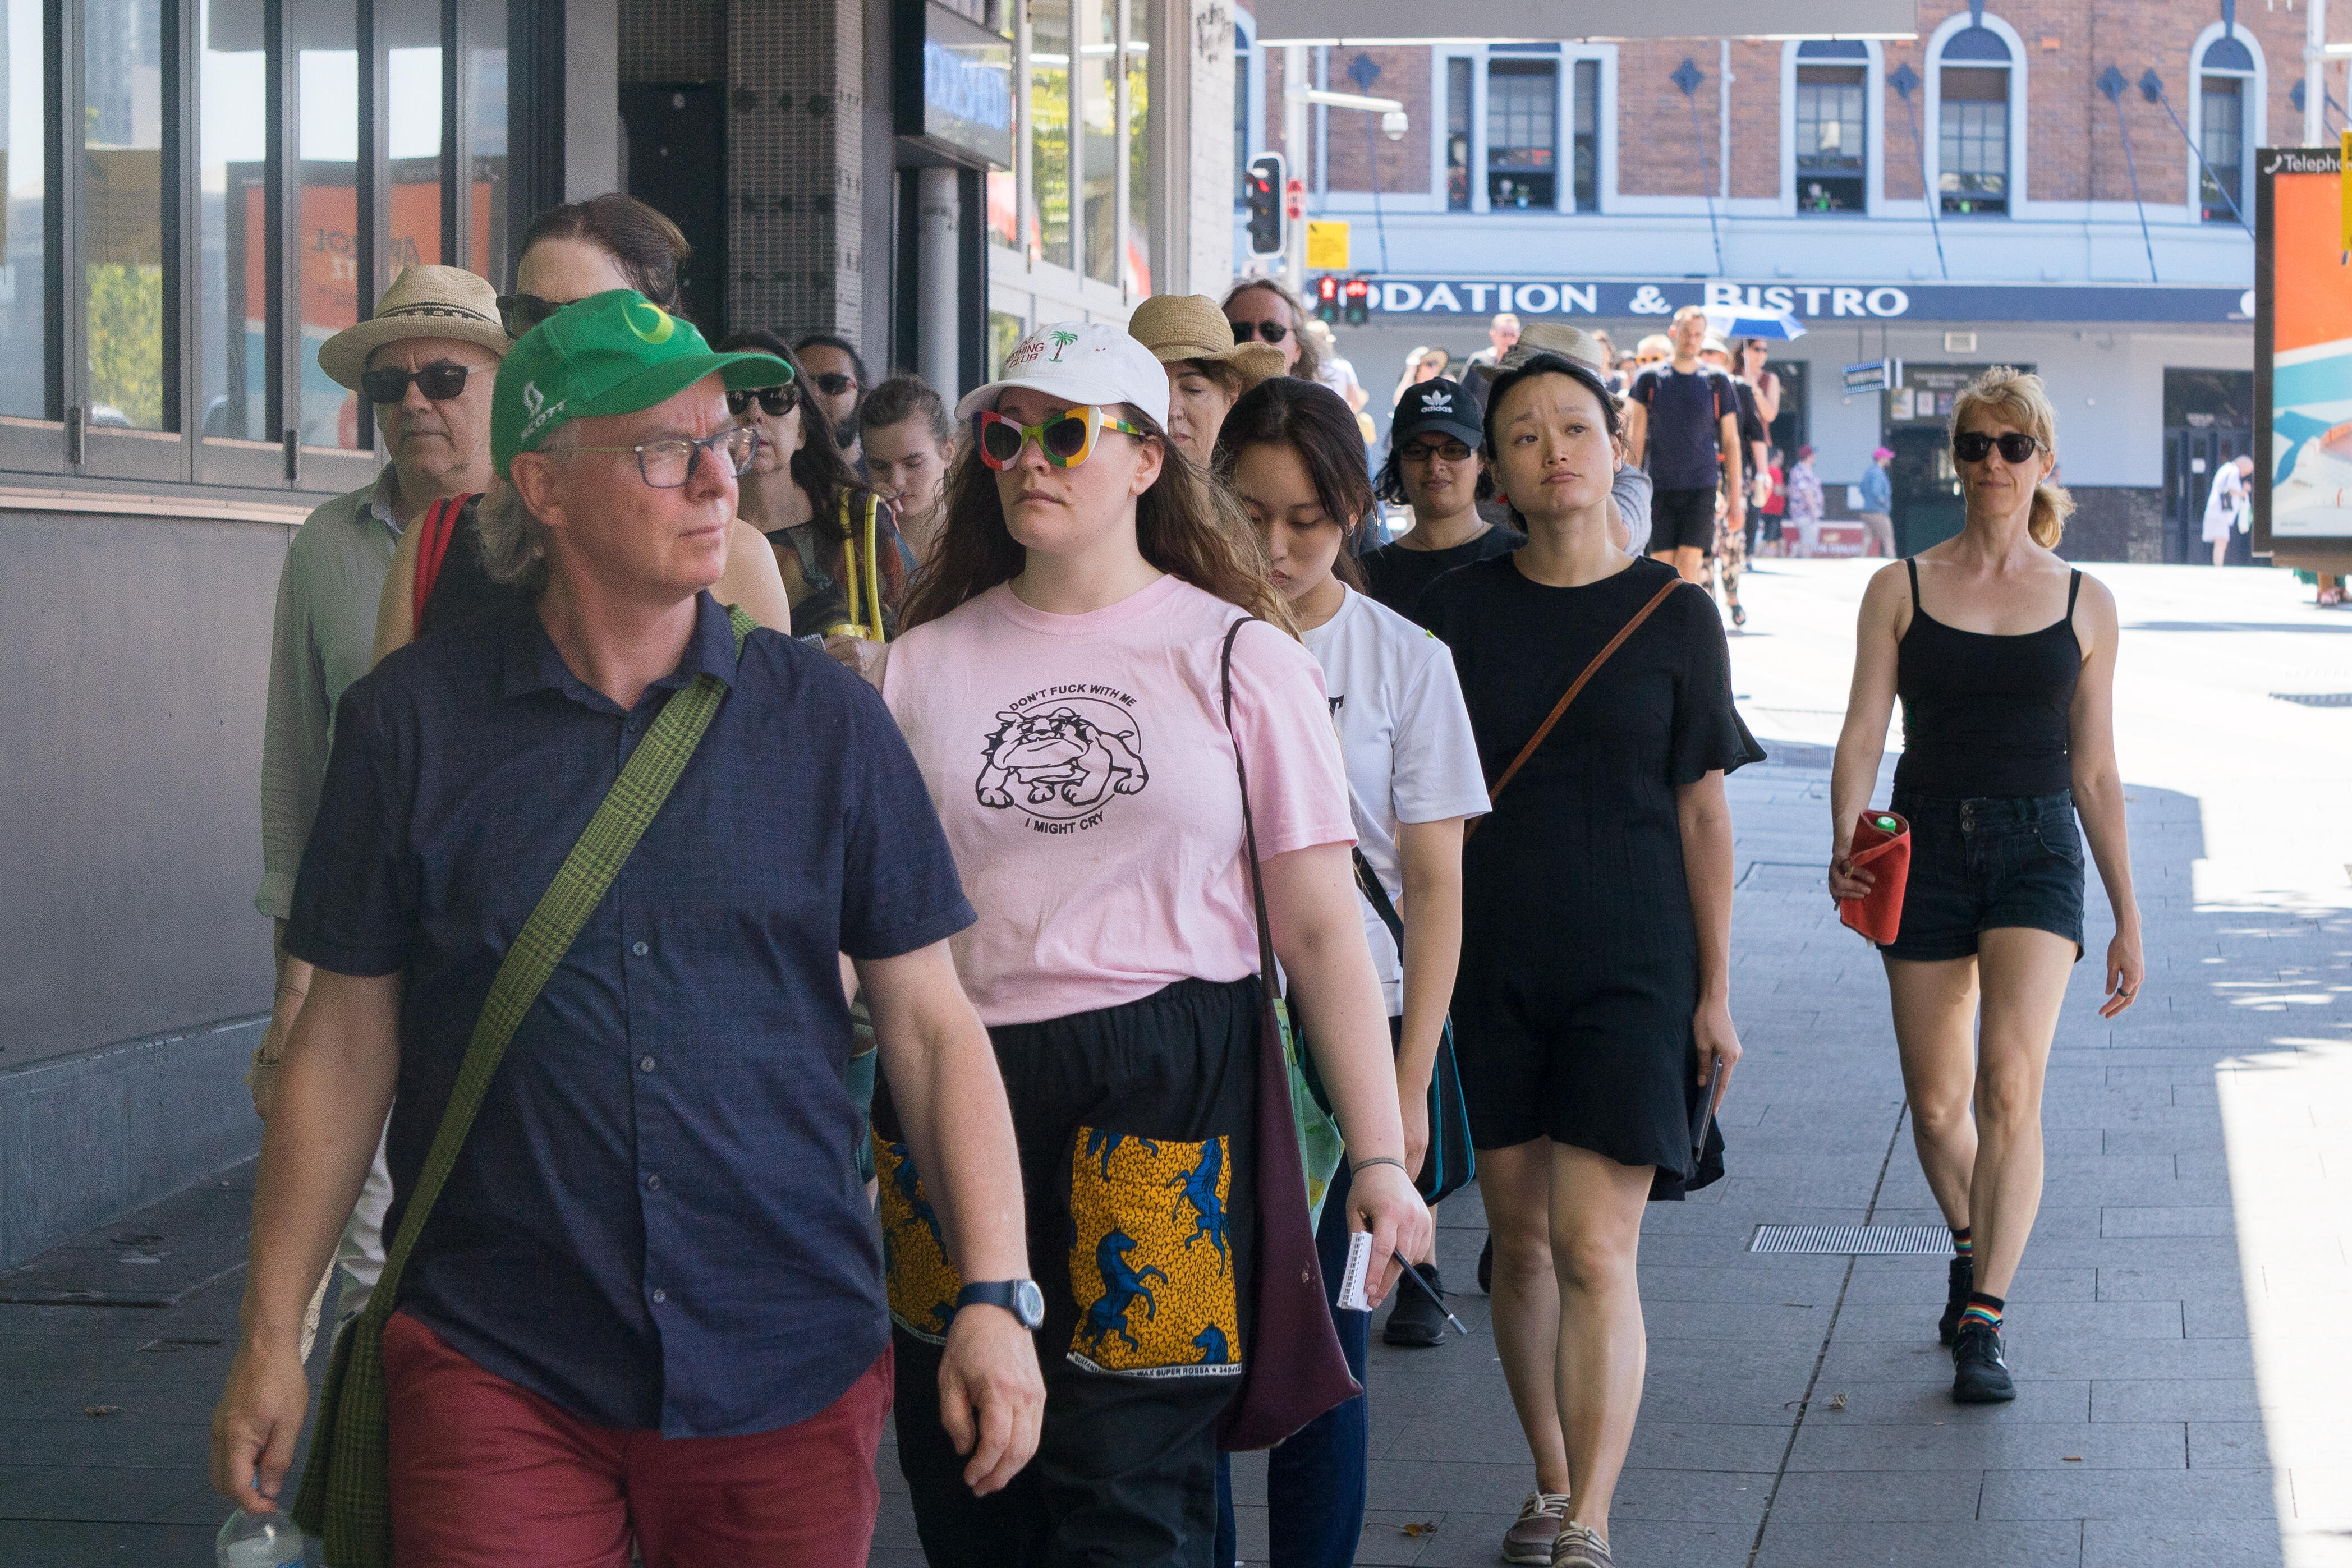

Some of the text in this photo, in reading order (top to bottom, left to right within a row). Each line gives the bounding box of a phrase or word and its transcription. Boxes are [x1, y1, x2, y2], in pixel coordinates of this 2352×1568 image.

[1629, 286, 1673, 315] &
[1704, 282, 1909, 317] BISTRO
[1009, 353, 1038, 368] CLUB
[1009, 684, 1137, 711] DON'T FUCK WITH ME
[1025, 810, 1104, 834] I MIGHT CRY
